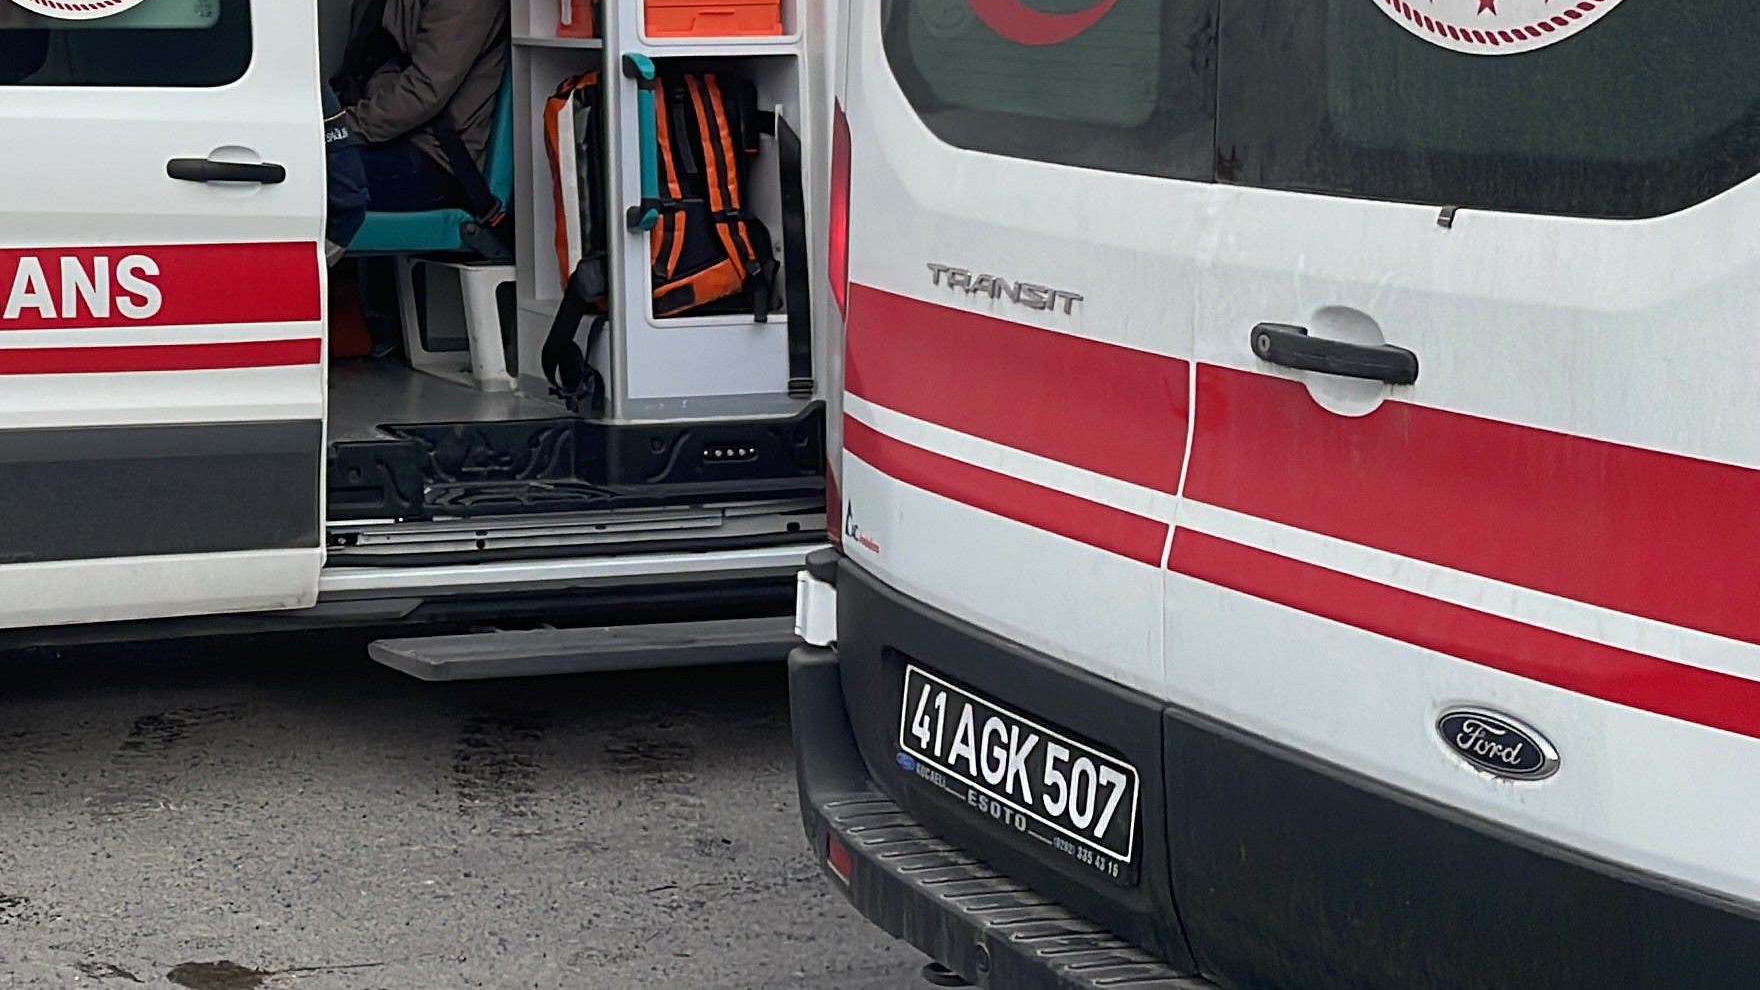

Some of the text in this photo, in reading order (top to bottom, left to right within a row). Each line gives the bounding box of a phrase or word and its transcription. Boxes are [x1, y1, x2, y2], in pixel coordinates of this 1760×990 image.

[926, 262, 1084, 315] TRANSIT
[1456, 719, 1523, 765] Ford
[947, 702, 1039, 805] AGK
[1042, 741, 1127, 839] 507
[967, 788, 1027, 832] ESOTO
